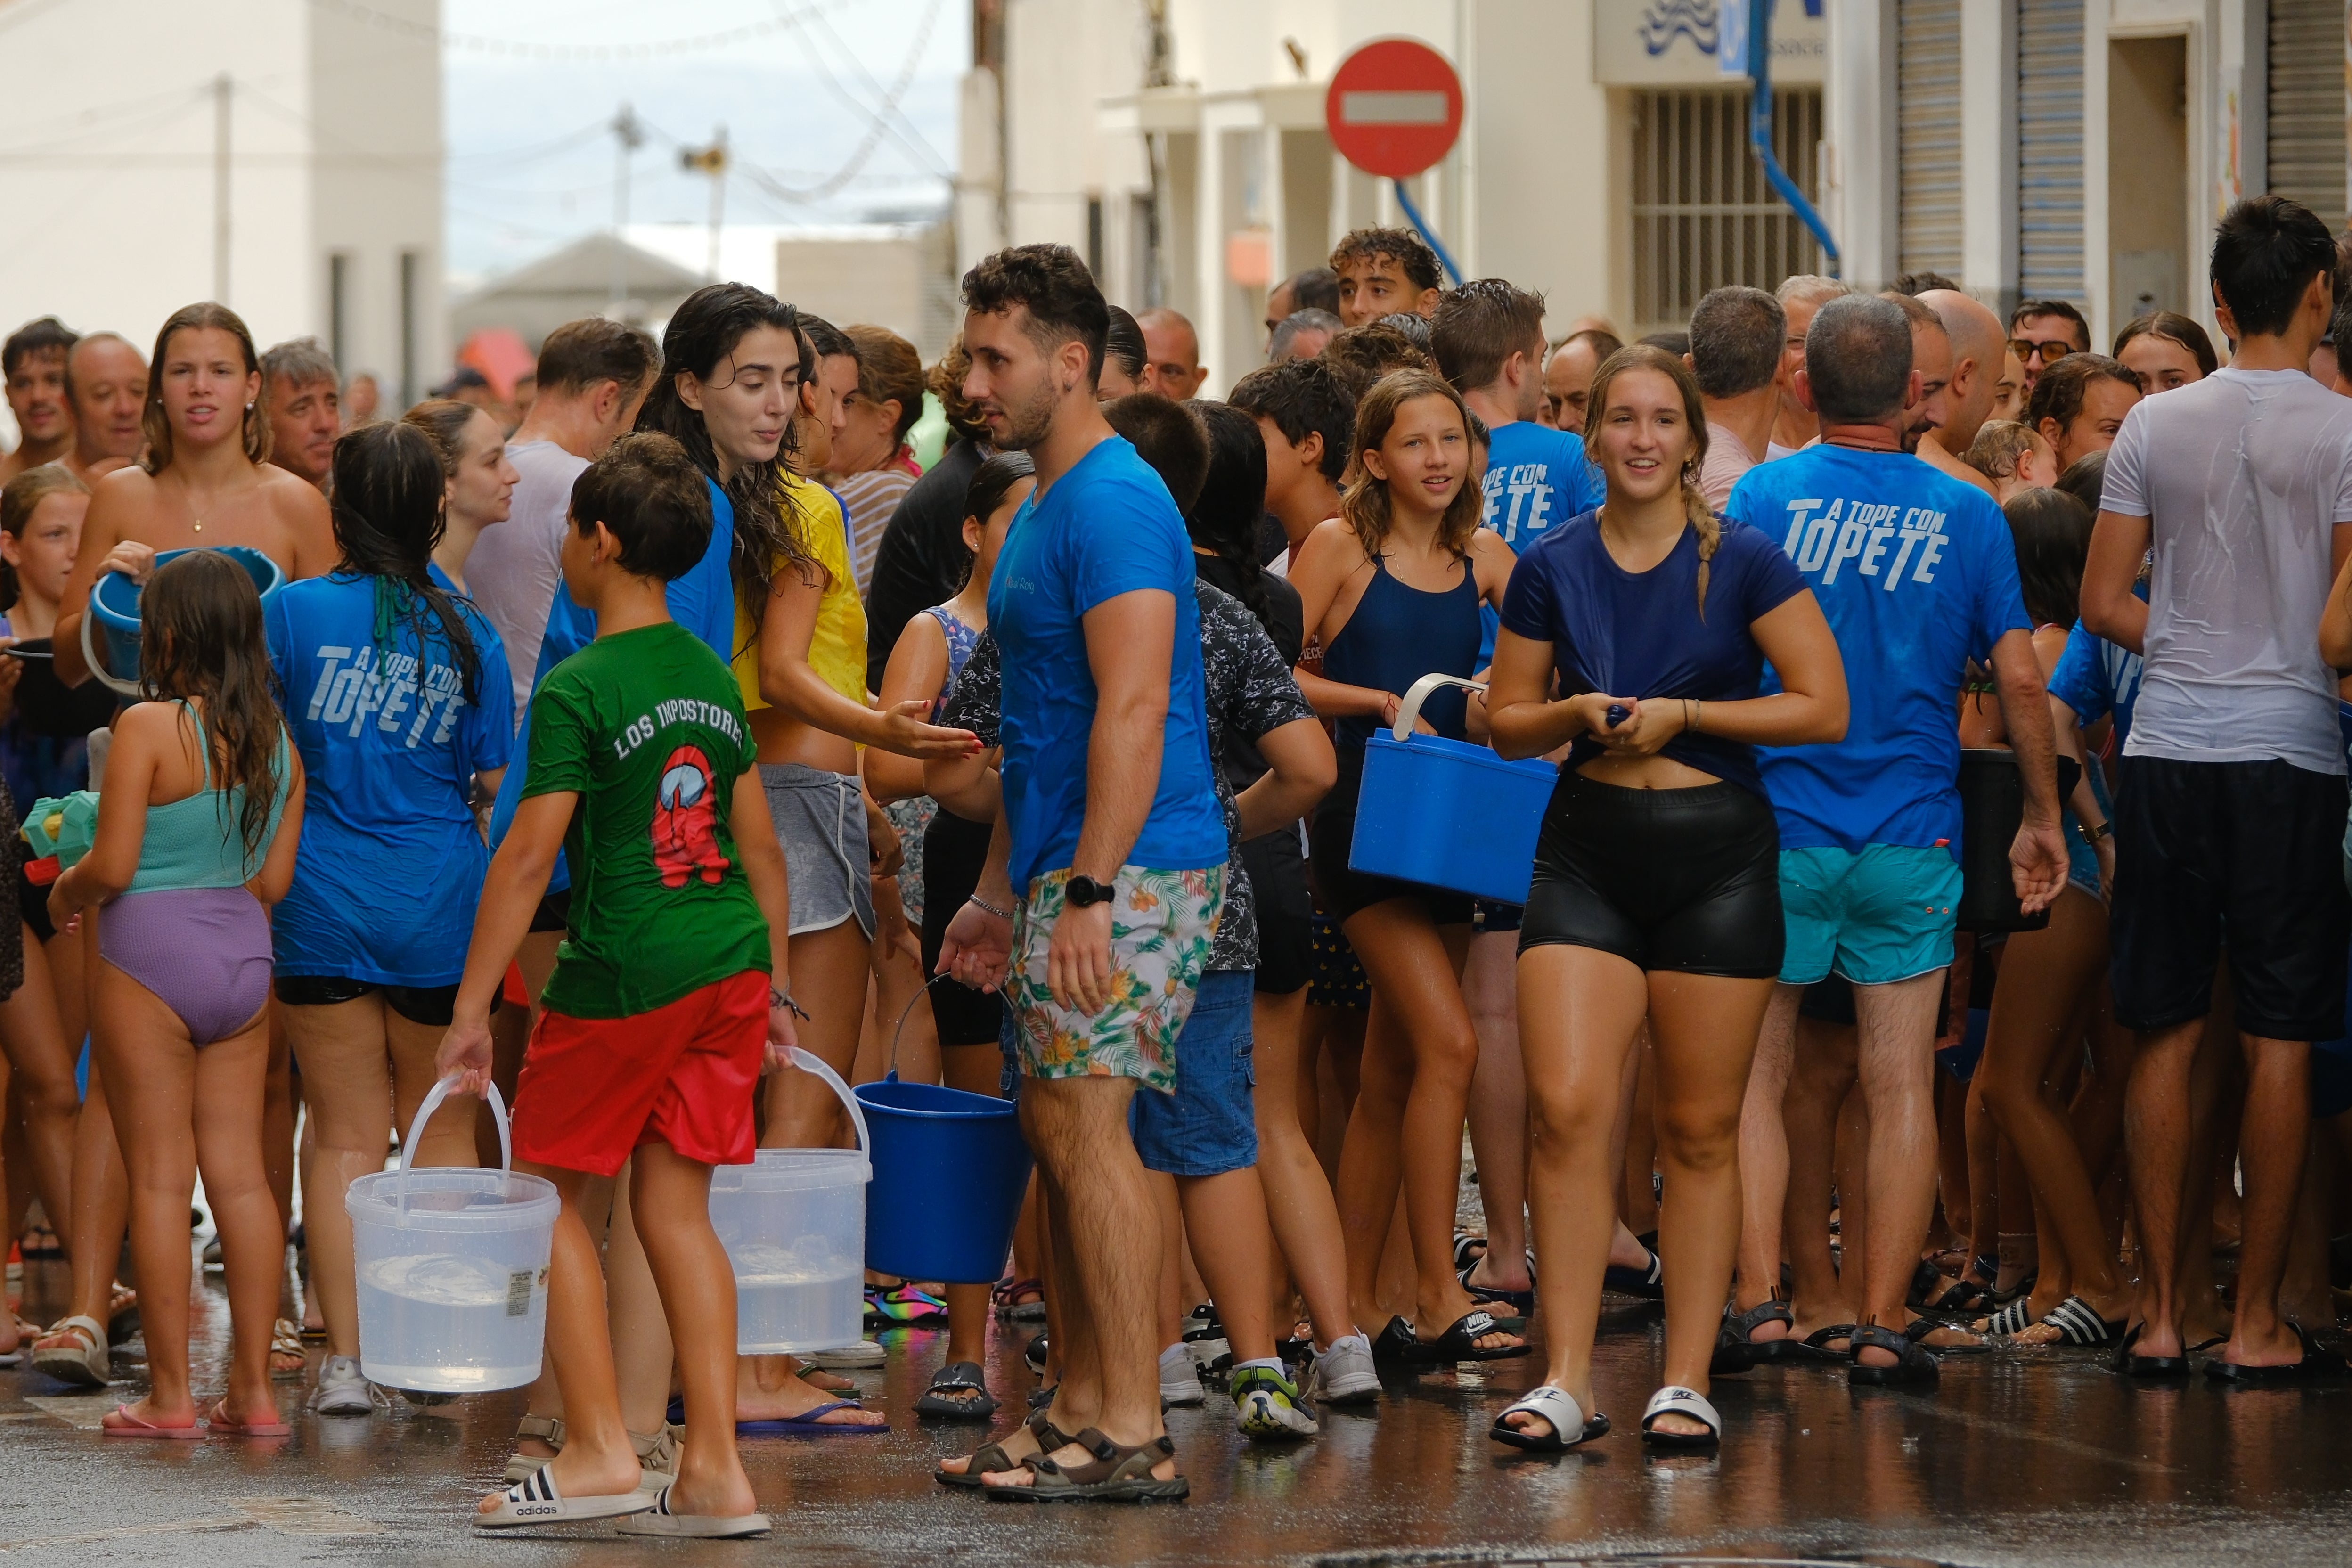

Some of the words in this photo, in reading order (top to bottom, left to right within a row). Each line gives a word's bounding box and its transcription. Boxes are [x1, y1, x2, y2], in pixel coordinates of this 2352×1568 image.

[1481, 466, 1507, 496] PE
[1509, 464, 1548, 488] CON
[1482, 484, 1554, 542] ETE
[1824, 498, 1844, 520] A
[1848, 500, 1901, 530] TOPE
[1902, 507, 1947, 537] CON
[1783, 498, 1949, 591] TOPETE
[1020, 577, 1034, 594] Roig
[353, 646, 371, 670] A
[307, 645, 467, 749] TOPETE
[613, 714, 655, 760] LOS
[1467, 1313, 1492, 1327] NIKE
[1663, 1389, 1695, 1399] IKE
[517, 1505, 557, 1516] adidas
